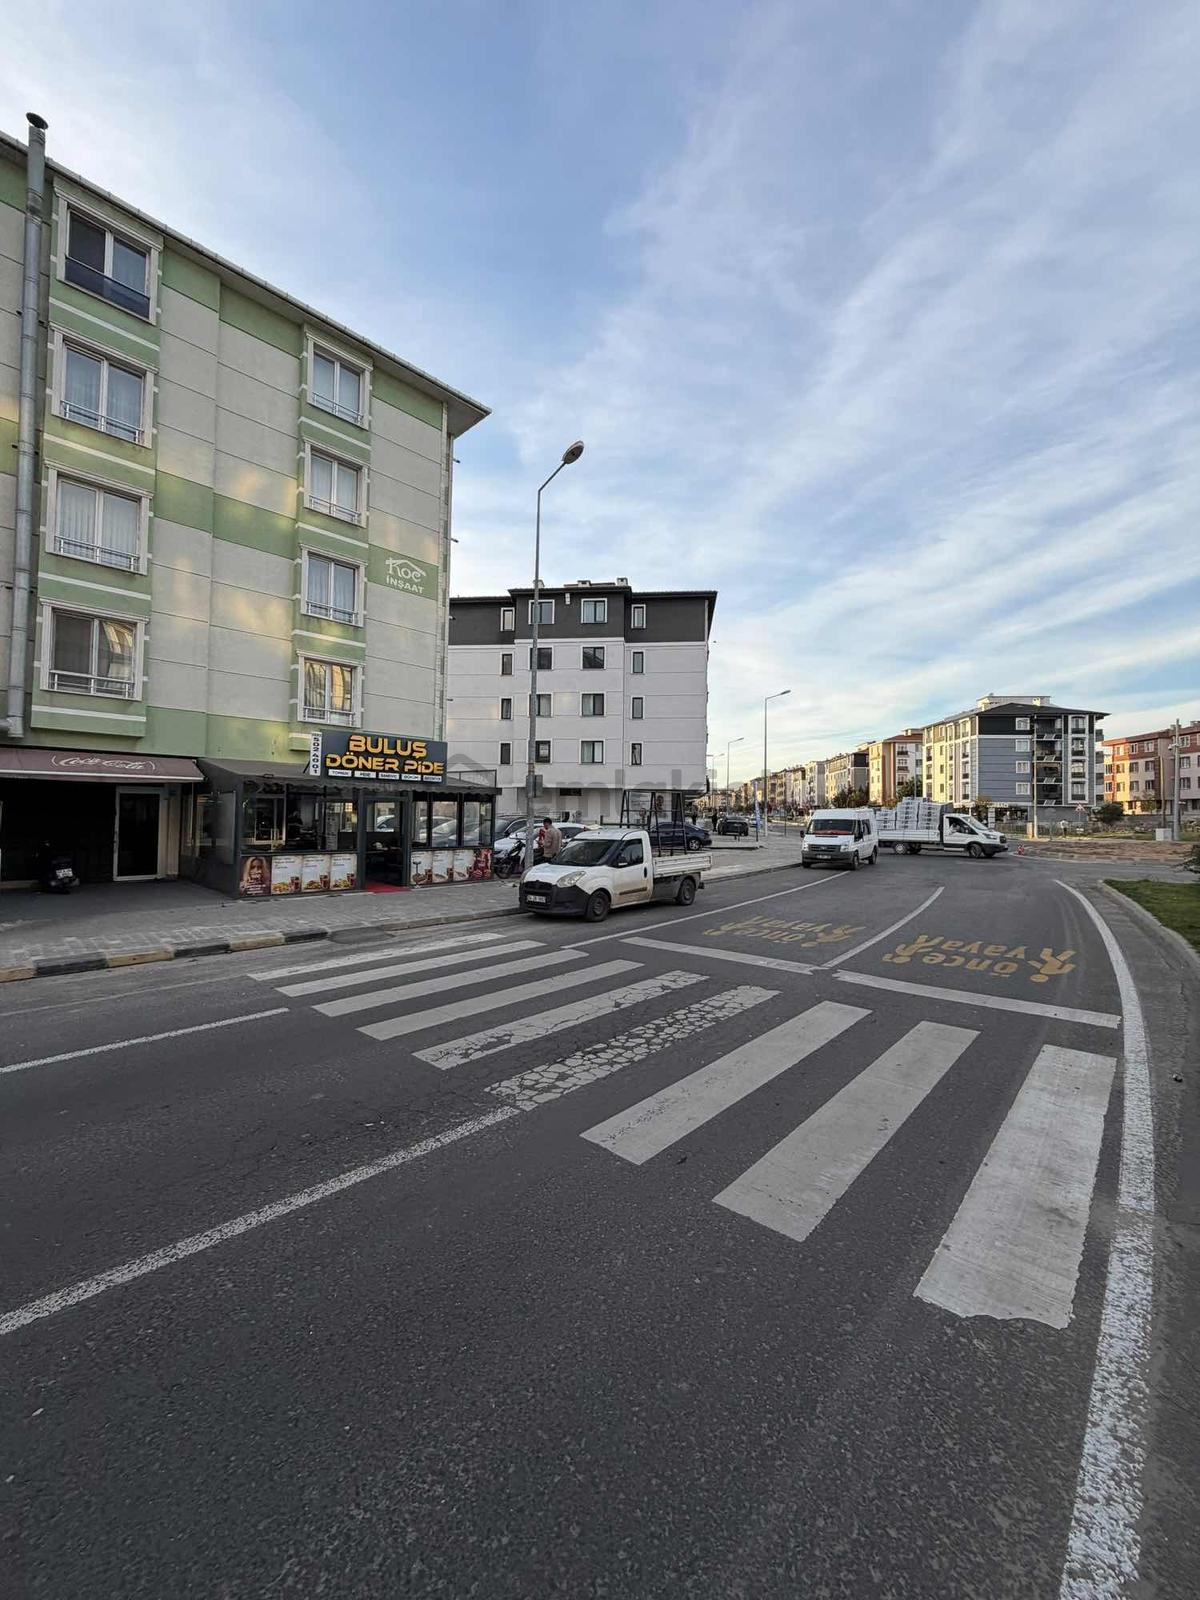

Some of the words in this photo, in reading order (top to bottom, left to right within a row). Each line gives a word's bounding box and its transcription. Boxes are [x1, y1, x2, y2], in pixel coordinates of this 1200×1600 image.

[349, 734, 428, 759] BULUŞ
[325, 751, 400, 772] DÖNER
[922, 952, 1019, 977] önce
